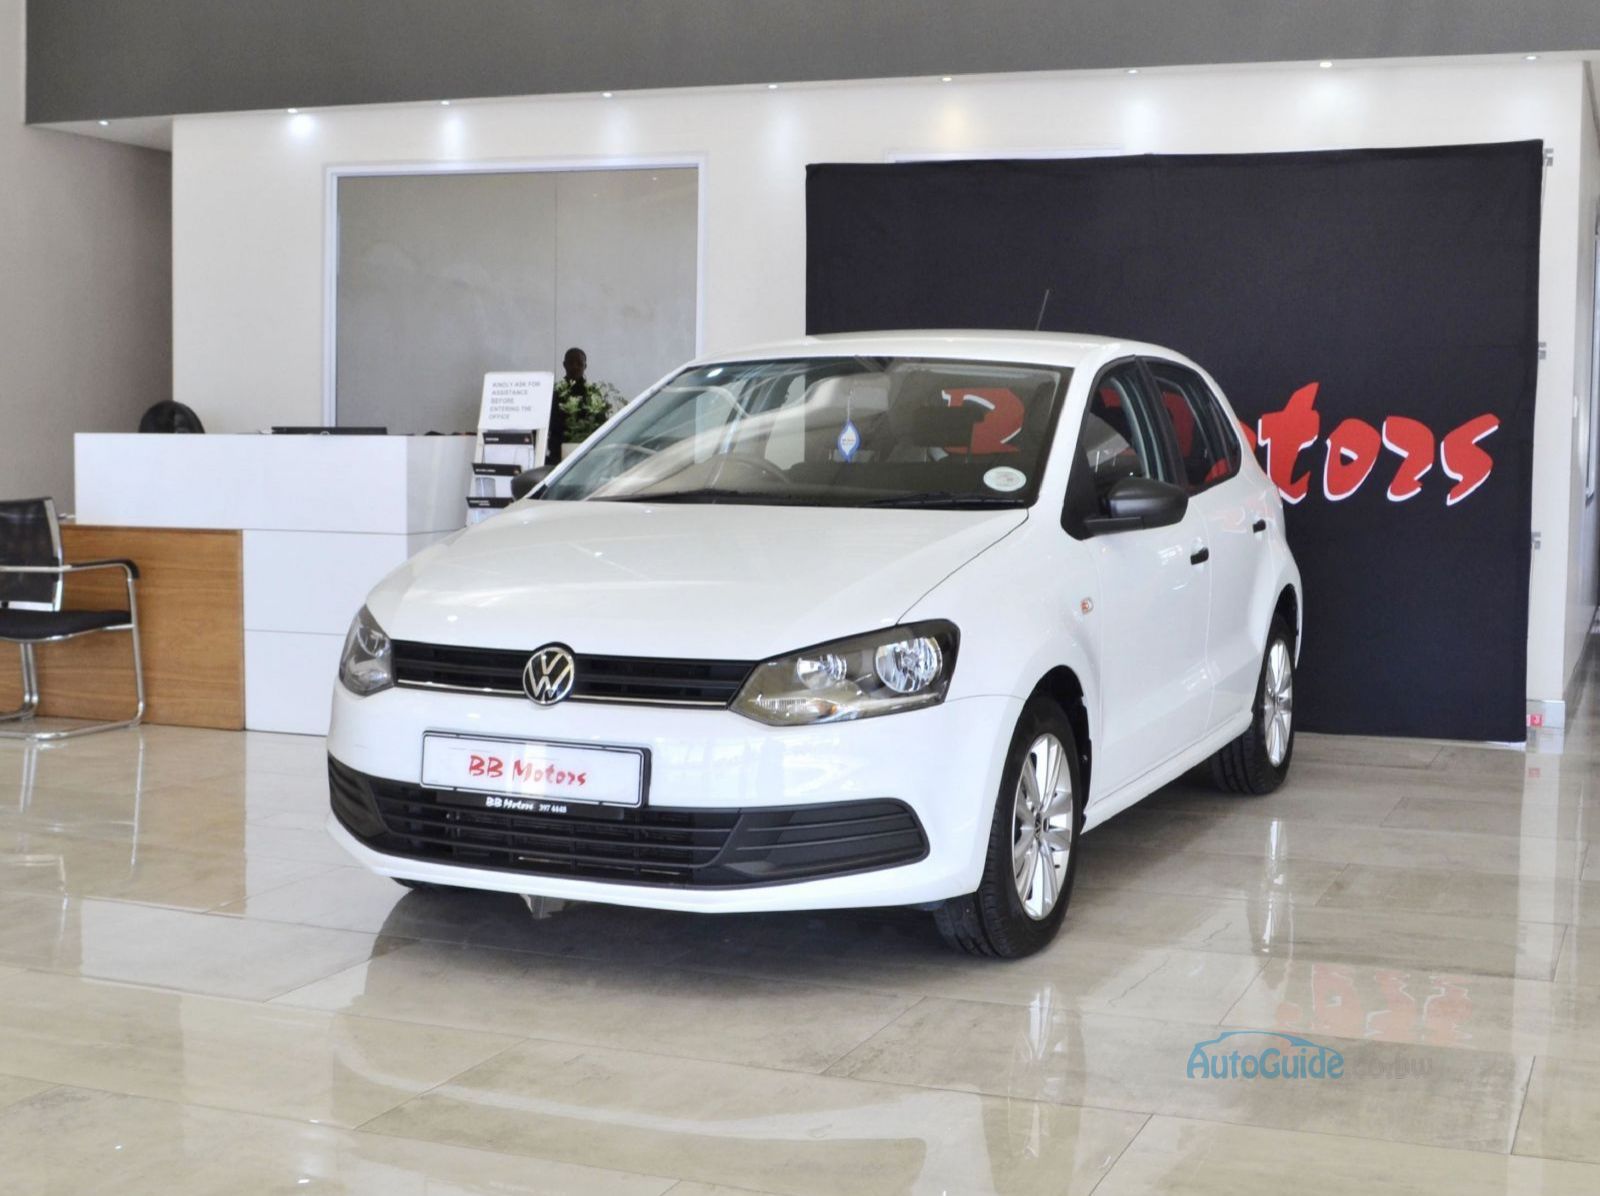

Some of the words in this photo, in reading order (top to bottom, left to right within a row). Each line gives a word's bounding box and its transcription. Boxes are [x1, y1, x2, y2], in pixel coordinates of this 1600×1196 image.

[469, 755, 504, 777] BB
[512, 759, 587, 786] Motors
[485, 796, 503, 808] BB
[503, 798, 534, 811] Motors
